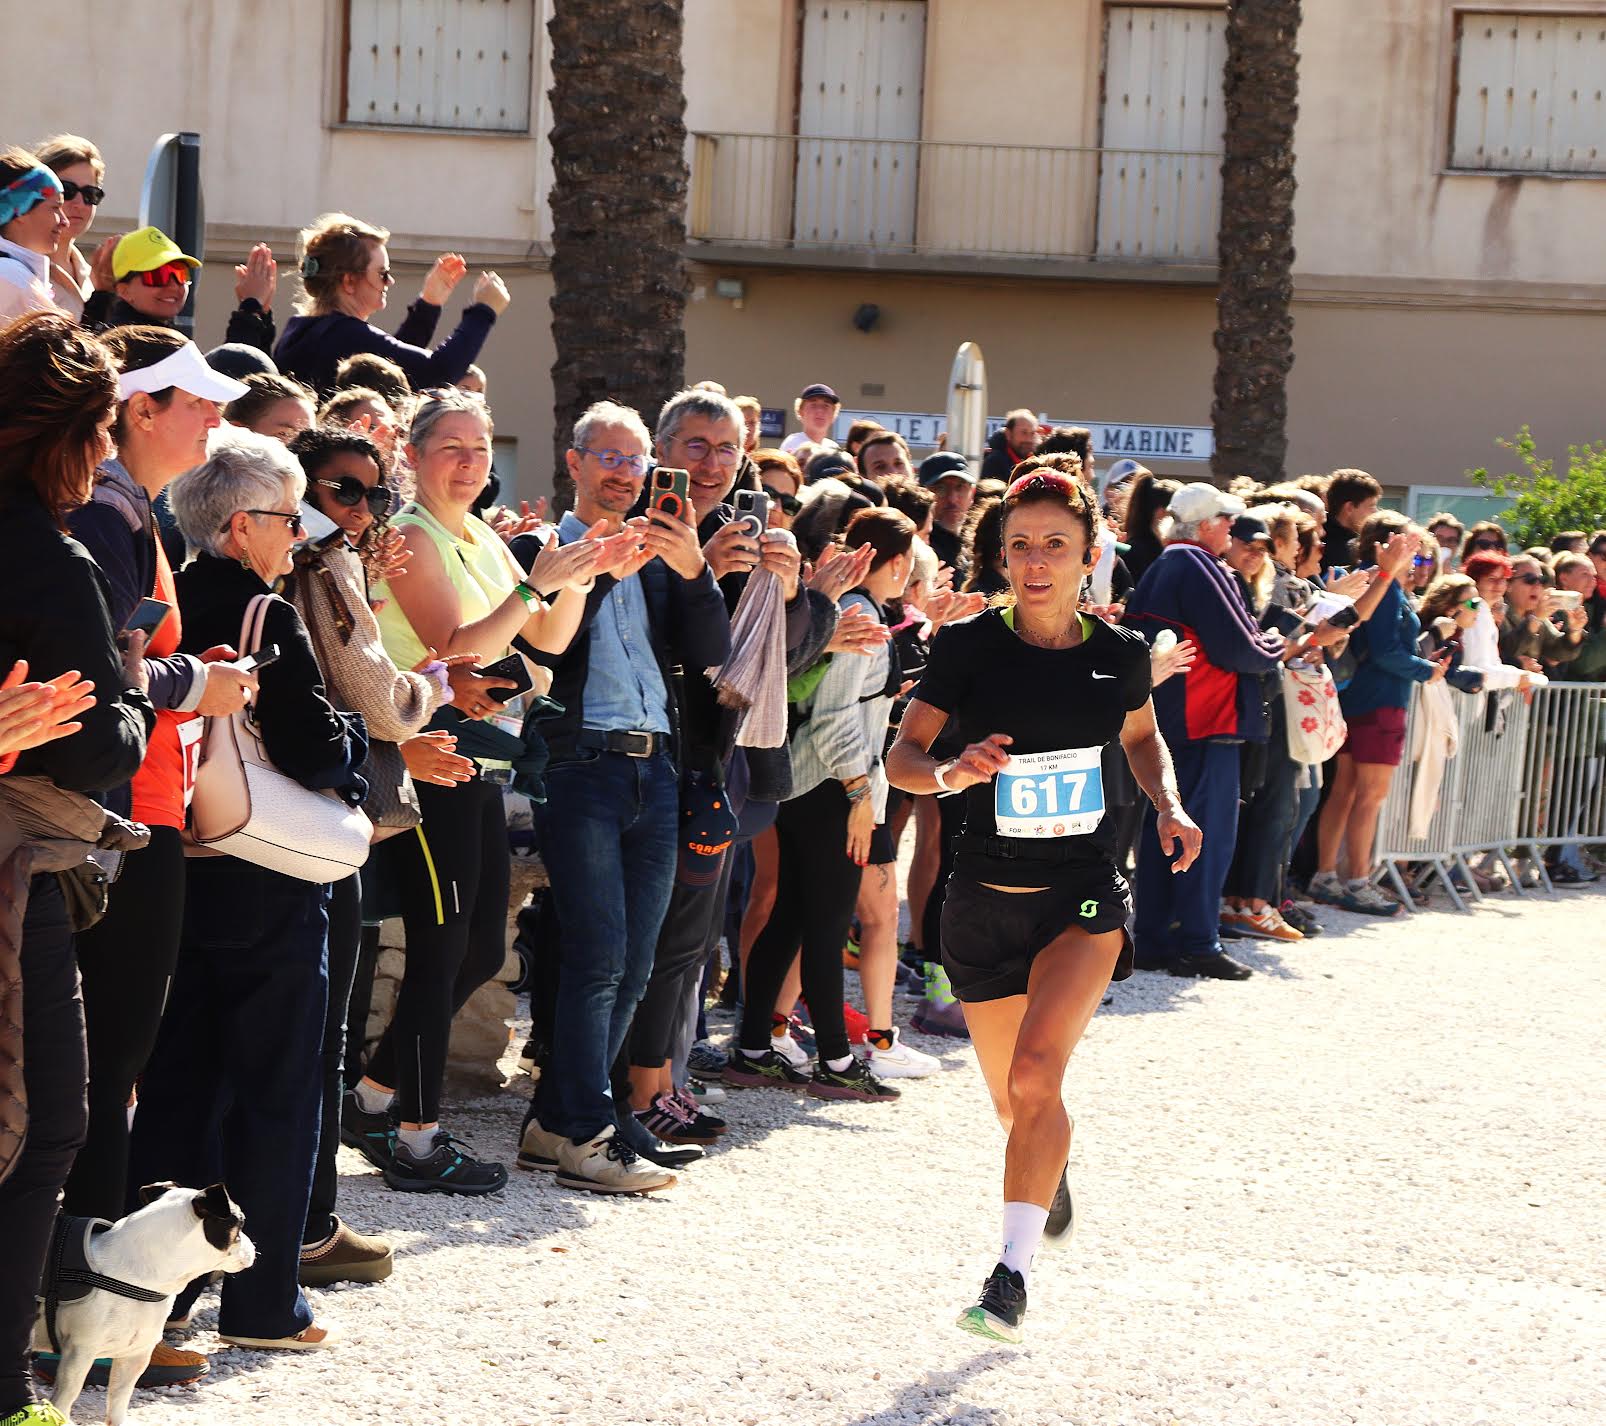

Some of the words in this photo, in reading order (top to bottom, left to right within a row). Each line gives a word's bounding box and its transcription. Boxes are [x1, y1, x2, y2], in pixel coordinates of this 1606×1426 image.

[1103, 429, 1194, 454] MARINE
[1046, 752, 1078, 762] BONIFACIO
[1011, 772, 1088, 815] 617
